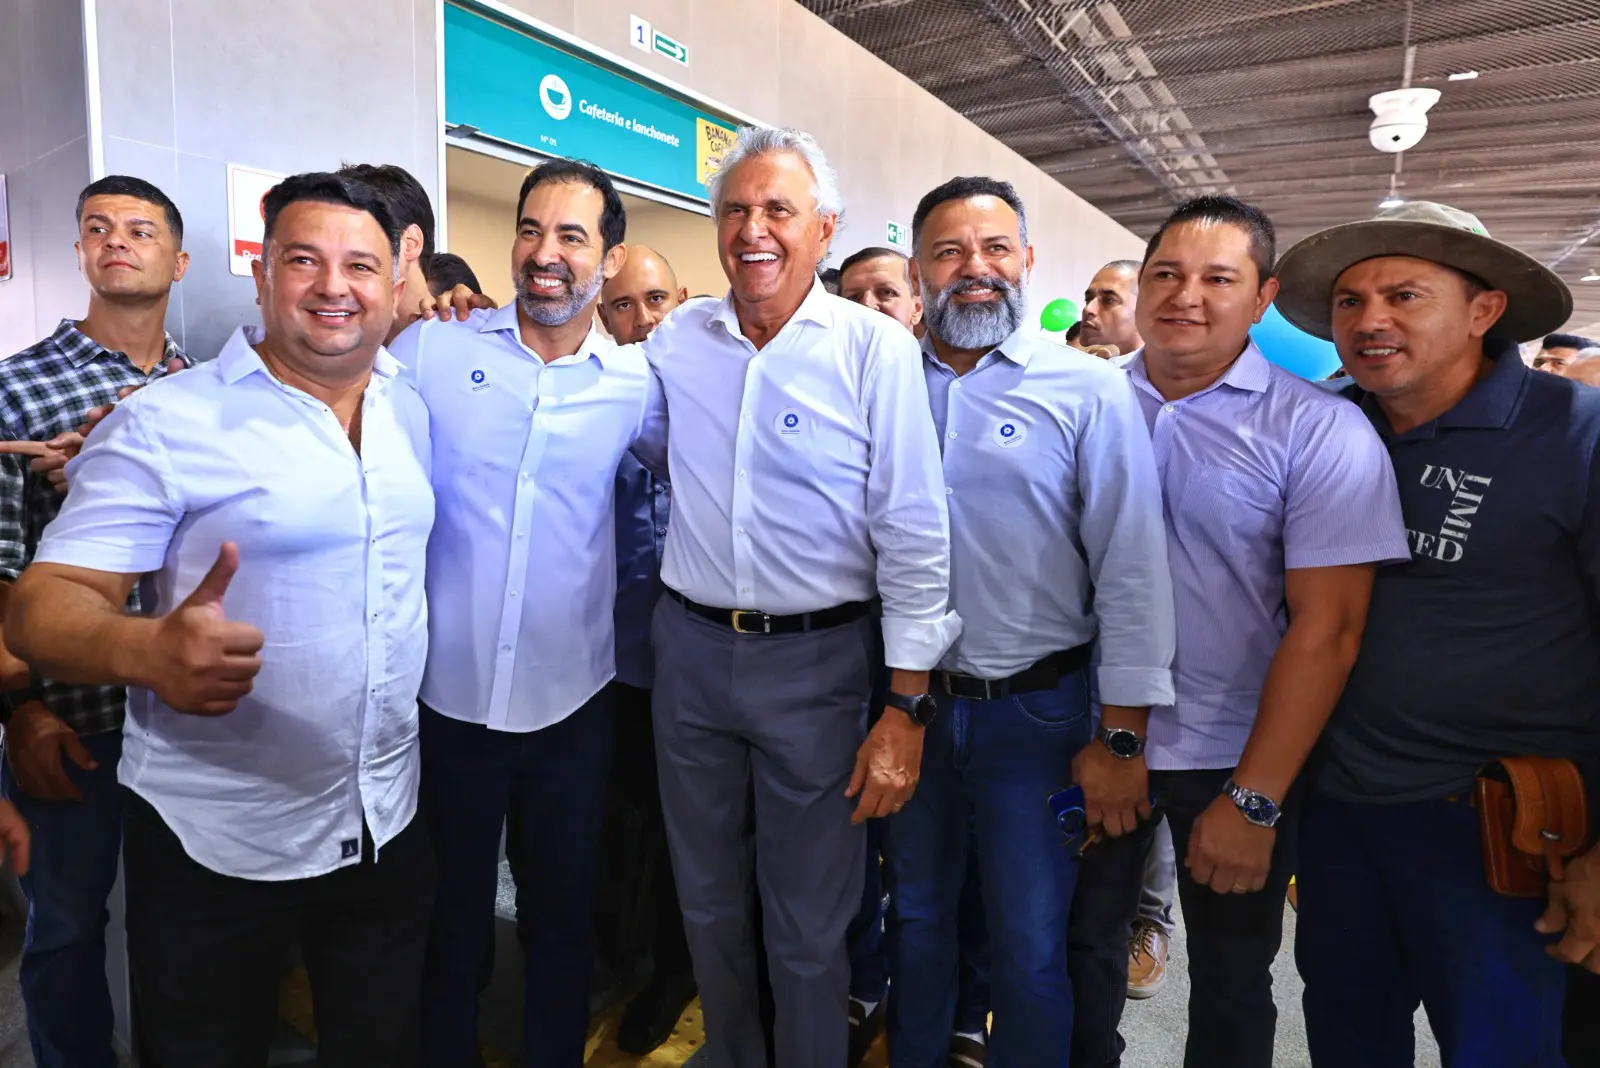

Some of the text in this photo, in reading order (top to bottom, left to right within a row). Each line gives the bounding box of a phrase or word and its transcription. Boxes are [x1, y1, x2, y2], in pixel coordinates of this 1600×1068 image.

[637, 25, 645, 44] 1
[579, 99, 680, 148] Cafeteria e lanchonete
[549, 137, 558, 147] 01
[1420, 464, 1466, 492] UN
